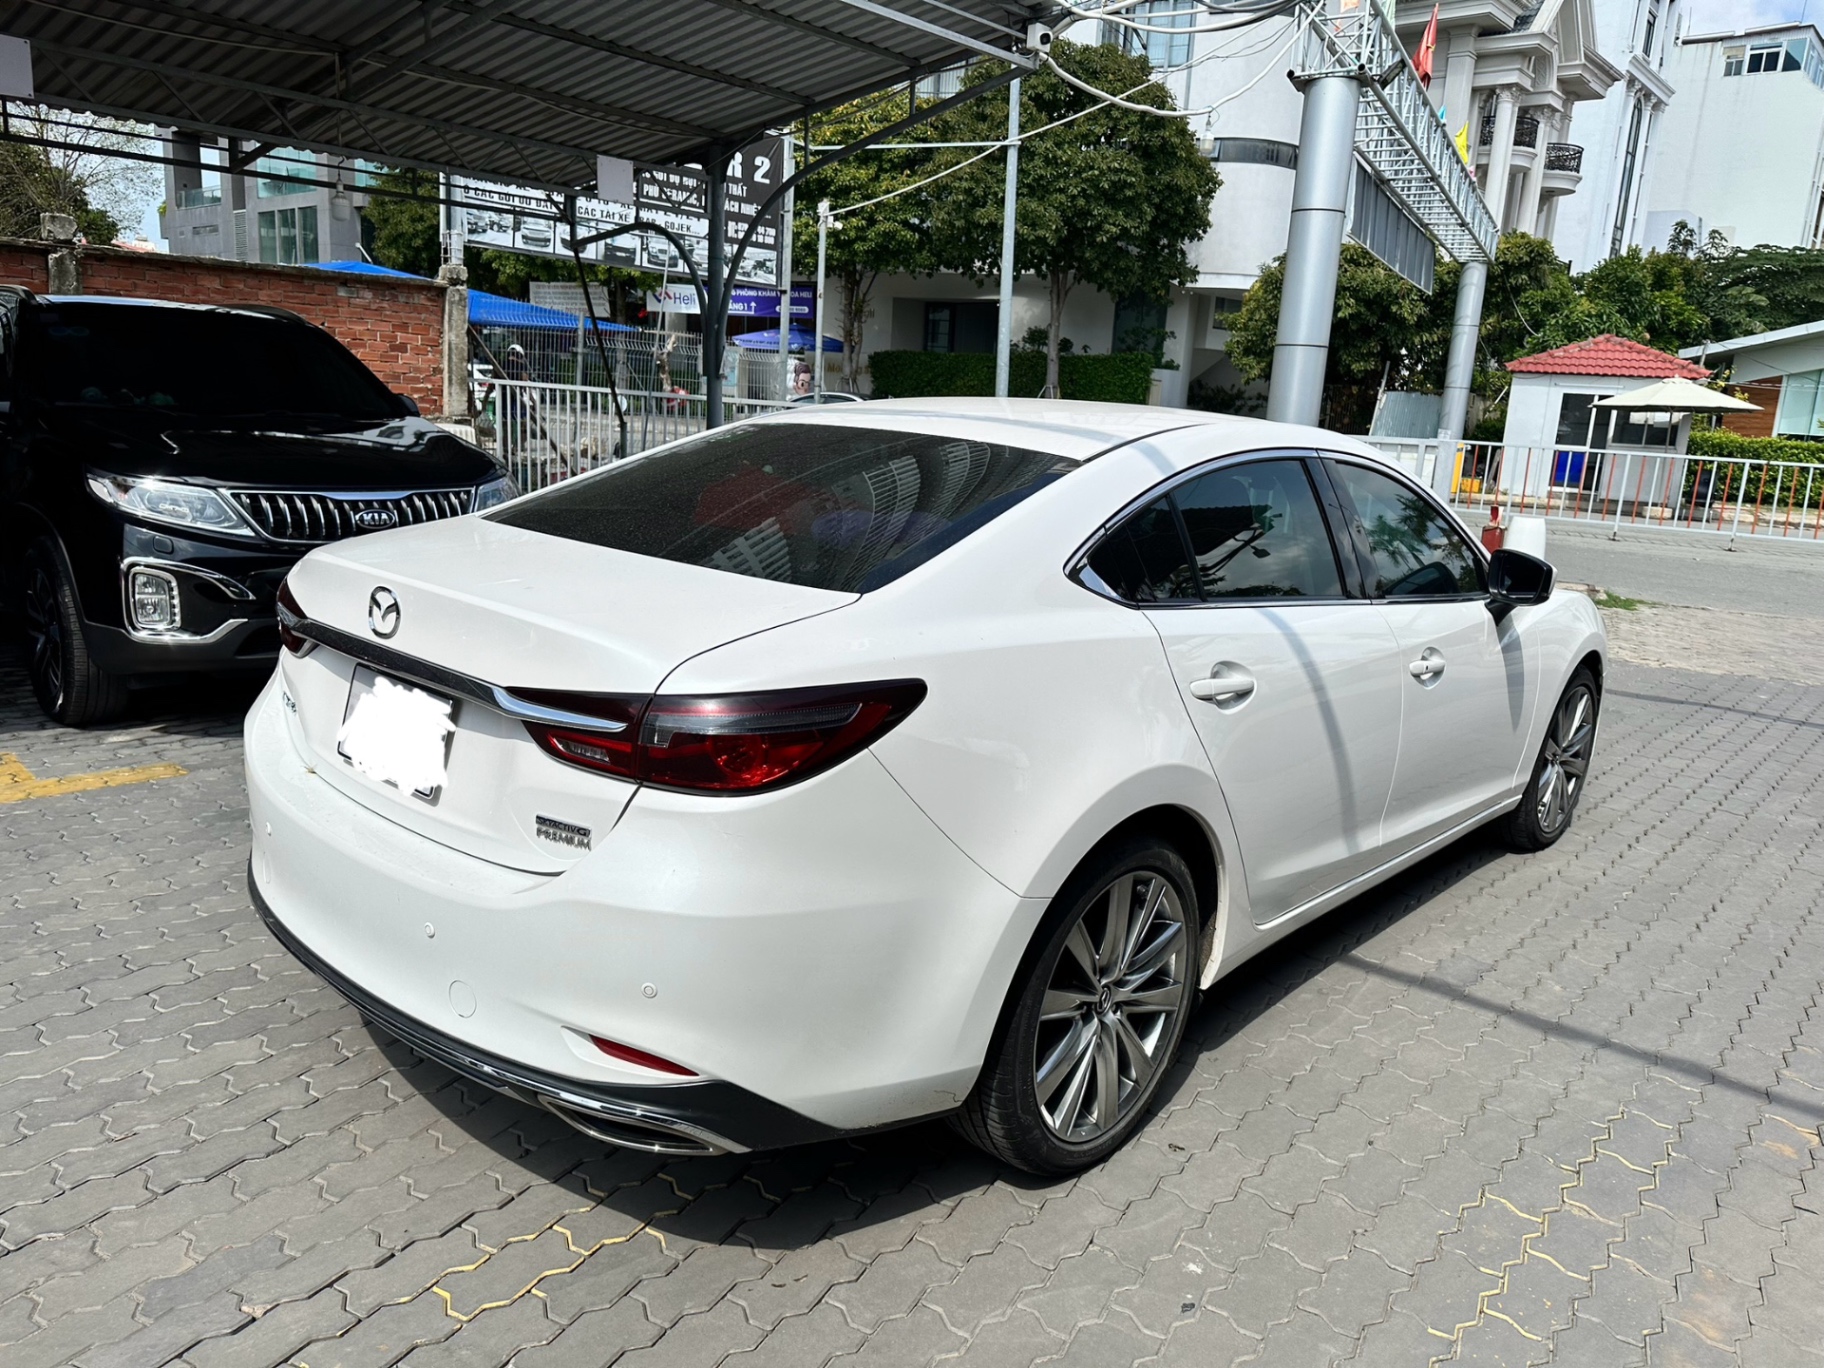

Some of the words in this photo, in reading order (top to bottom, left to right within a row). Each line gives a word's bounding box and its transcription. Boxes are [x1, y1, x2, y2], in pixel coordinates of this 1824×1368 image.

[753, 155, 771, 185] 2
[576, 204, 597, 217] CÁC
[673, 292, 696, 305] Heli
[362, 512, 390, 525] KIA
[536, 825, 592, 852] PREMIUM
